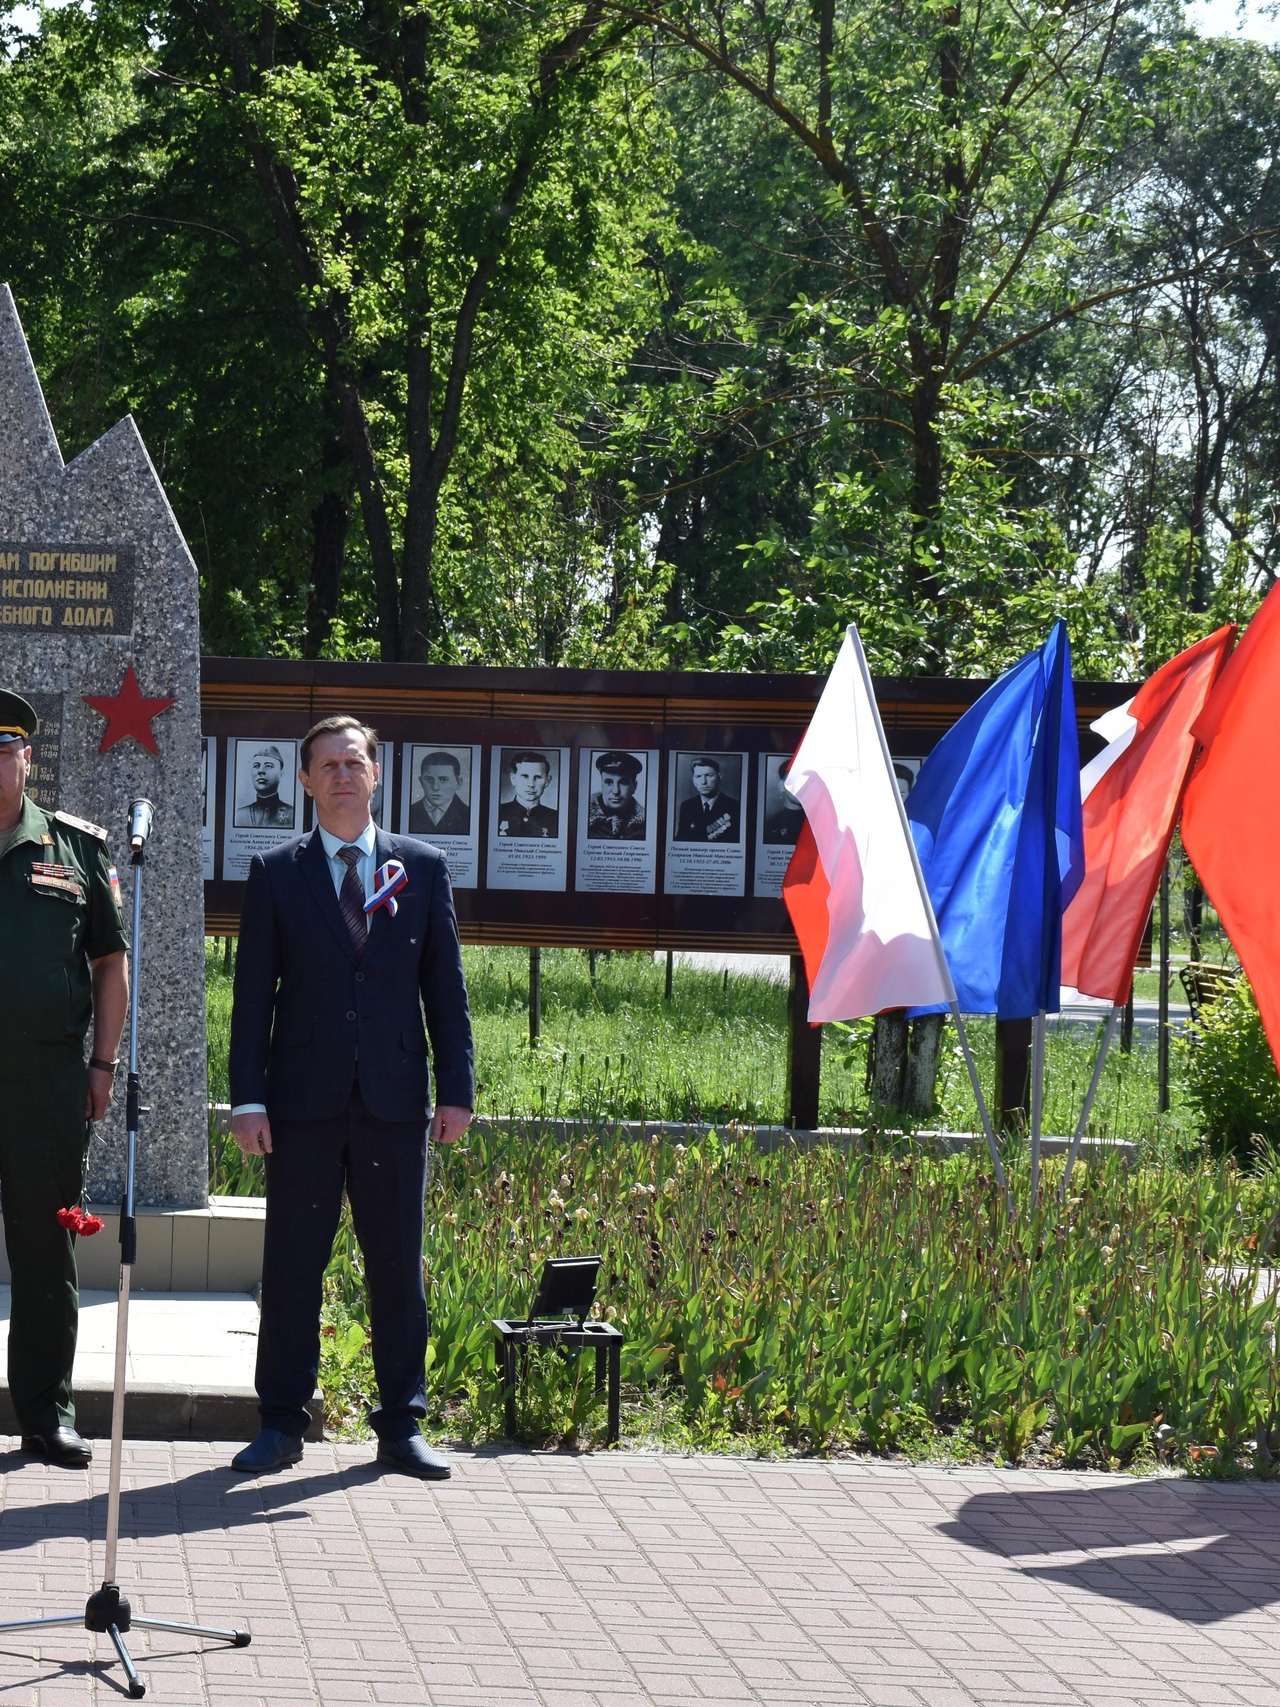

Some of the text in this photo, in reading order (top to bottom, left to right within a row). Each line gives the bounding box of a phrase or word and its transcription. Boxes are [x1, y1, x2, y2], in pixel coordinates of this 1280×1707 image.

[29, 552, 117, 572] ПОГИБШИМ
[2, 579, 108, 600] ИСПОЛНЕНИИ
[61, 607, 114, 627] ДОЛГА
[40, 773, 55, 781] 1982
